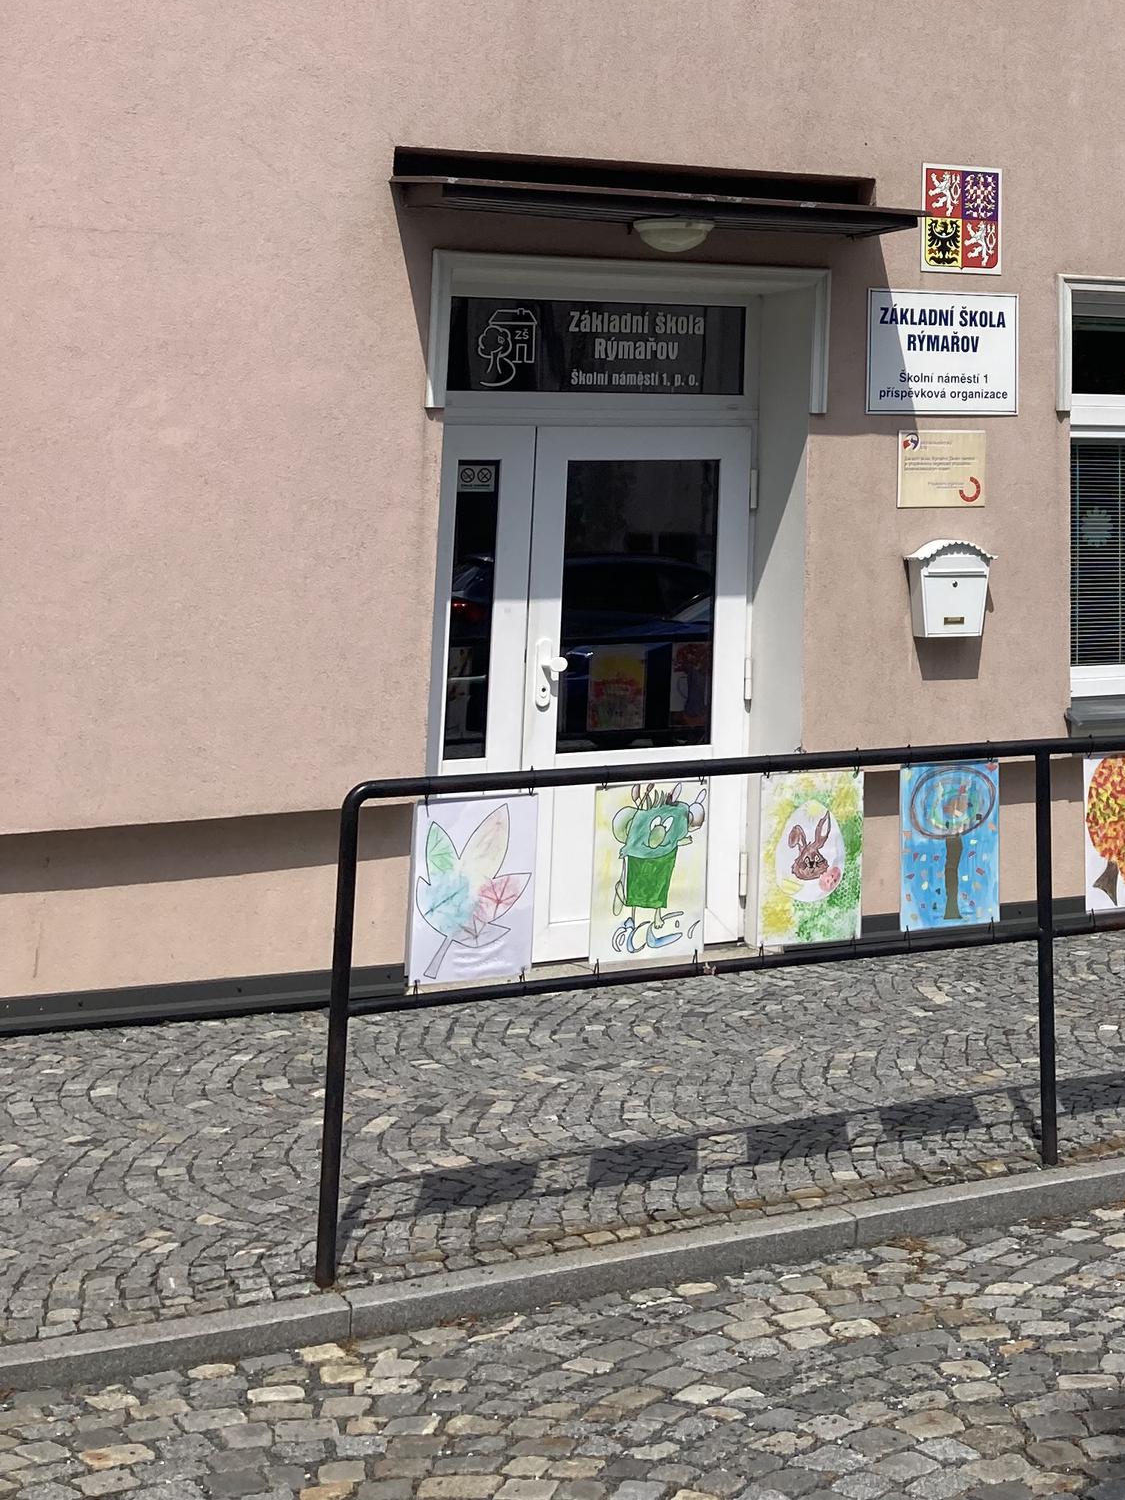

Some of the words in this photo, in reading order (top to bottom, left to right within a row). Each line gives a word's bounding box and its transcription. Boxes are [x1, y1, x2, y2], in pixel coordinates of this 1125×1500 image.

[568, 310, 649, 334] Základní
[655, 312, 705, 335] škola
[879, 304, 955, 326] ZÁKLADNÍ
[959, 306, 1006, 328] ŠKOLA
[594, 337, 679, 361] Rýmařov
[907, 331, 979, 352] RÝMAŘOV
[571, 369, 608, 386] Školní
[612, 371, 659, 386] náměstí
[899, 369, 934, 384] Školní
[937, 372, 980, 384] náměstí
[983, 374, 989, 383] 1
[879, 387, 946, 400] příspěvková
[950, 389, 1008, 401] organizace
